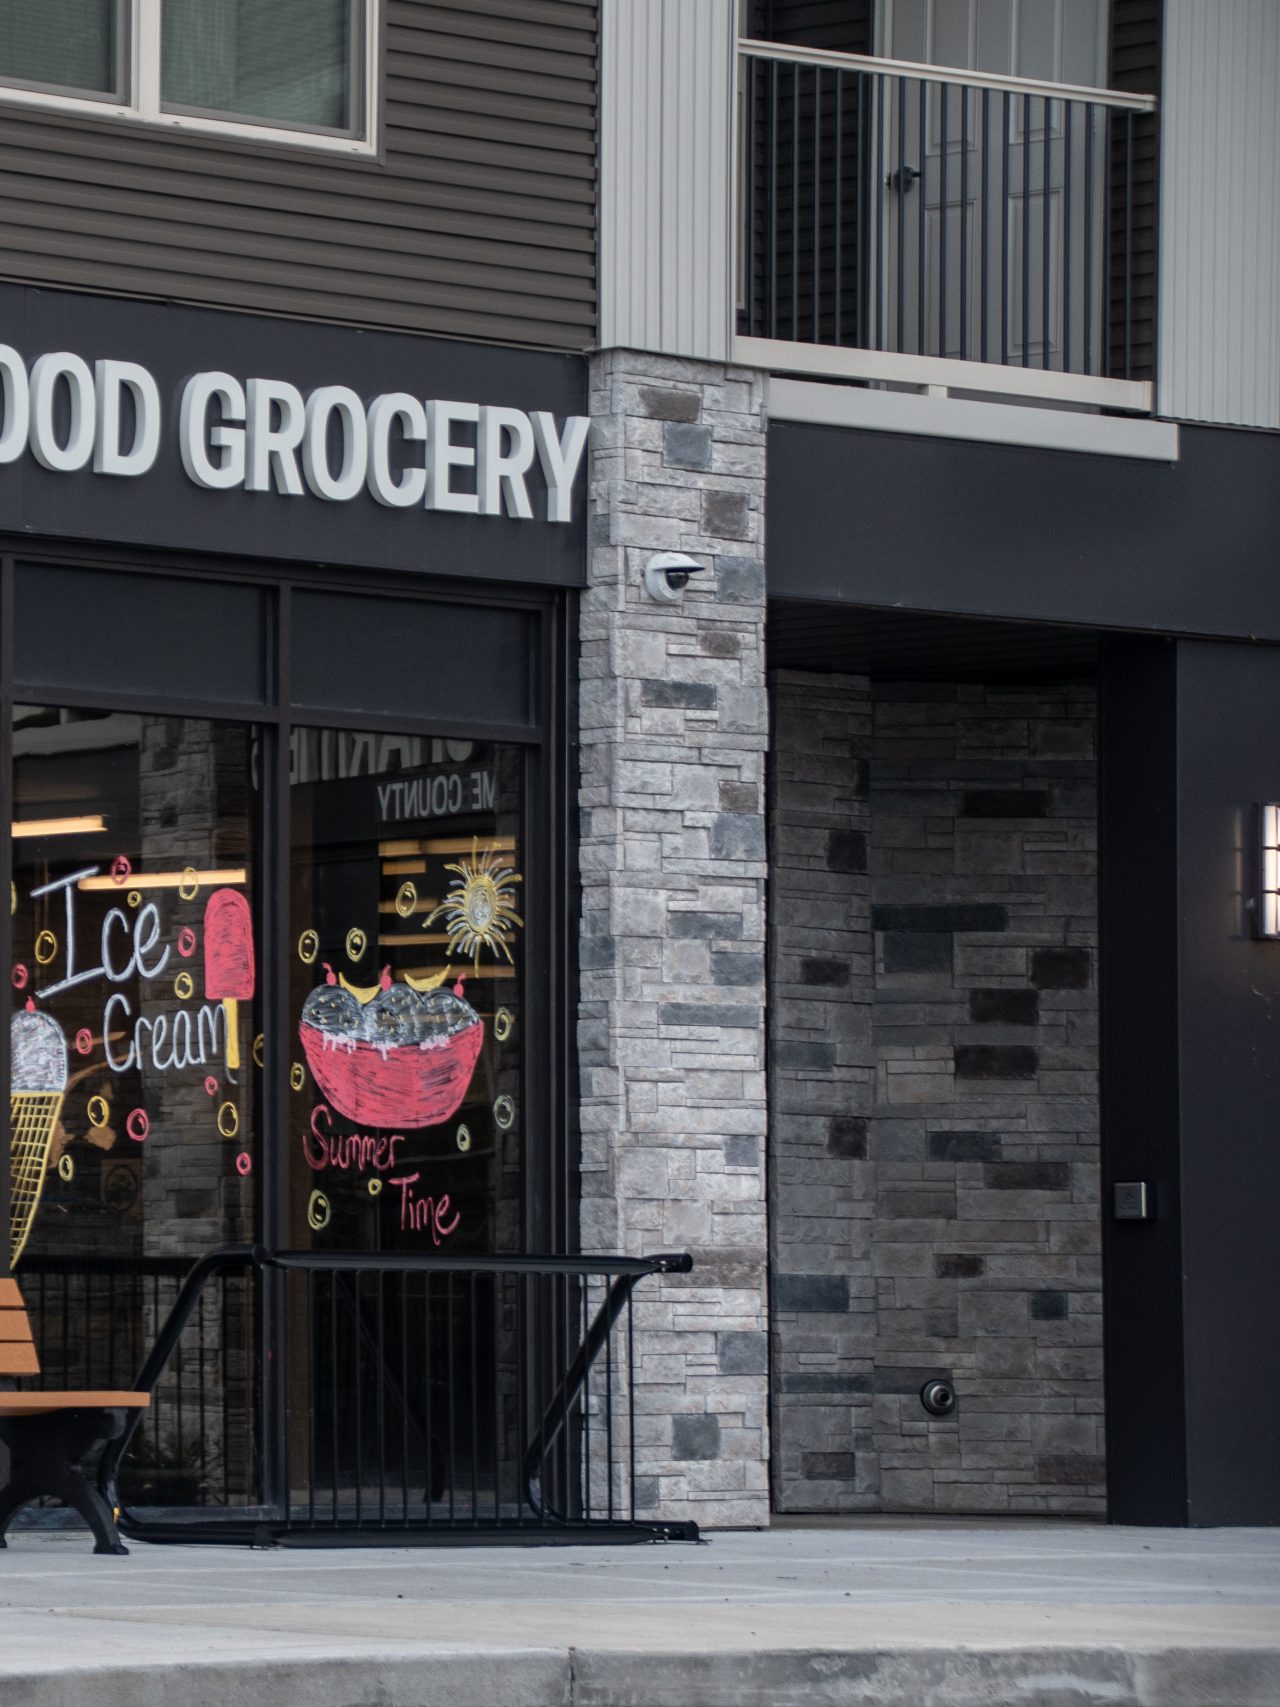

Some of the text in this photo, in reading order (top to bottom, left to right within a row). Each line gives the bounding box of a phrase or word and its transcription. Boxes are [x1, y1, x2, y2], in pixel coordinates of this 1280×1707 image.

[180, 370, 590, 522] GROCERY
[30, 865, 169, 998] Ice
[104, 994, 237, 1084] Cream
[302, 1104, 405, 1171] Summer
[388, 1172, 461, 1247] Time
